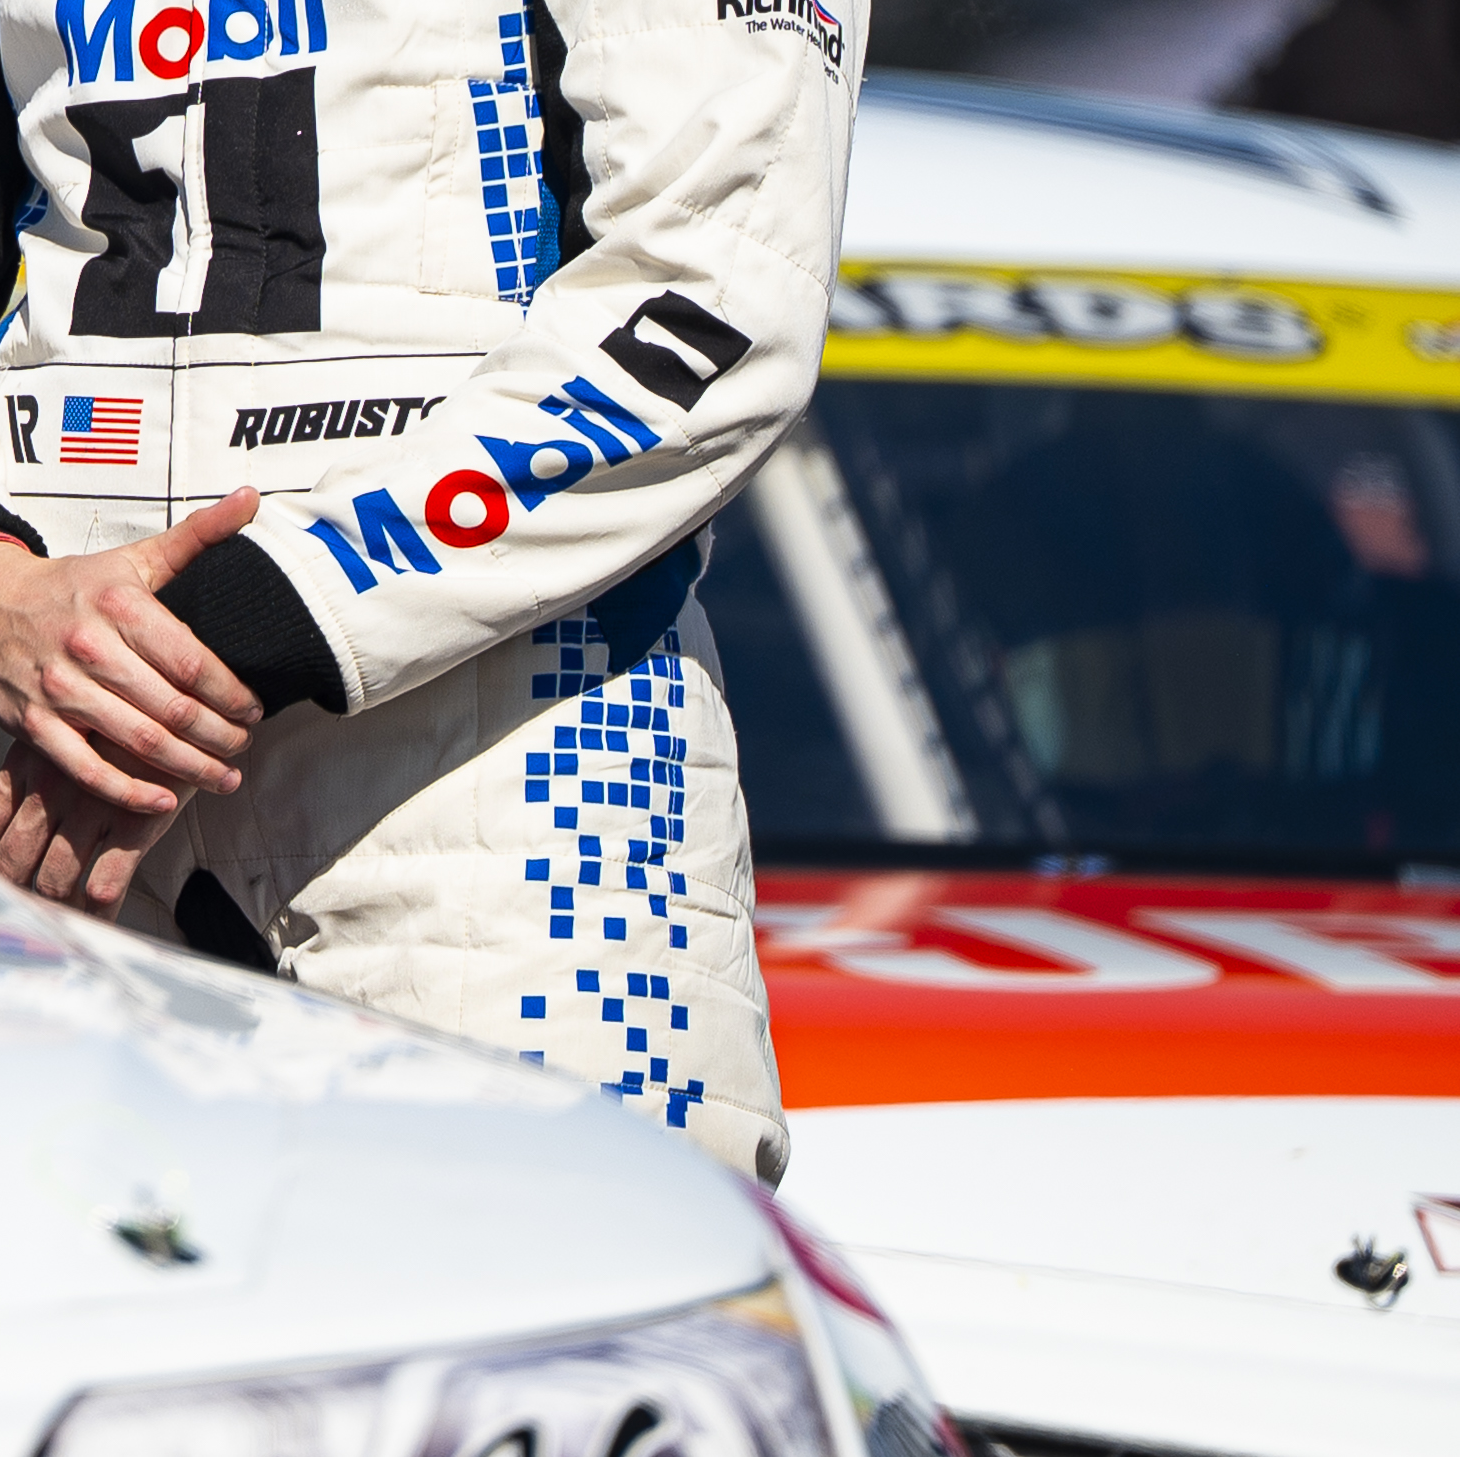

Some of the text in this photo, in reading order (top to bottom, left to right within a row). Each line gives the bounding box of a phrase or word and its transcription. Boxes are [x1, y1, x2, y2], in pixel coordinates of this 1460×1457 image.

[746, 20, 767, 34] The
[770, 18, 805, 37] Water
[306, 376, 662, 594] Mobil
